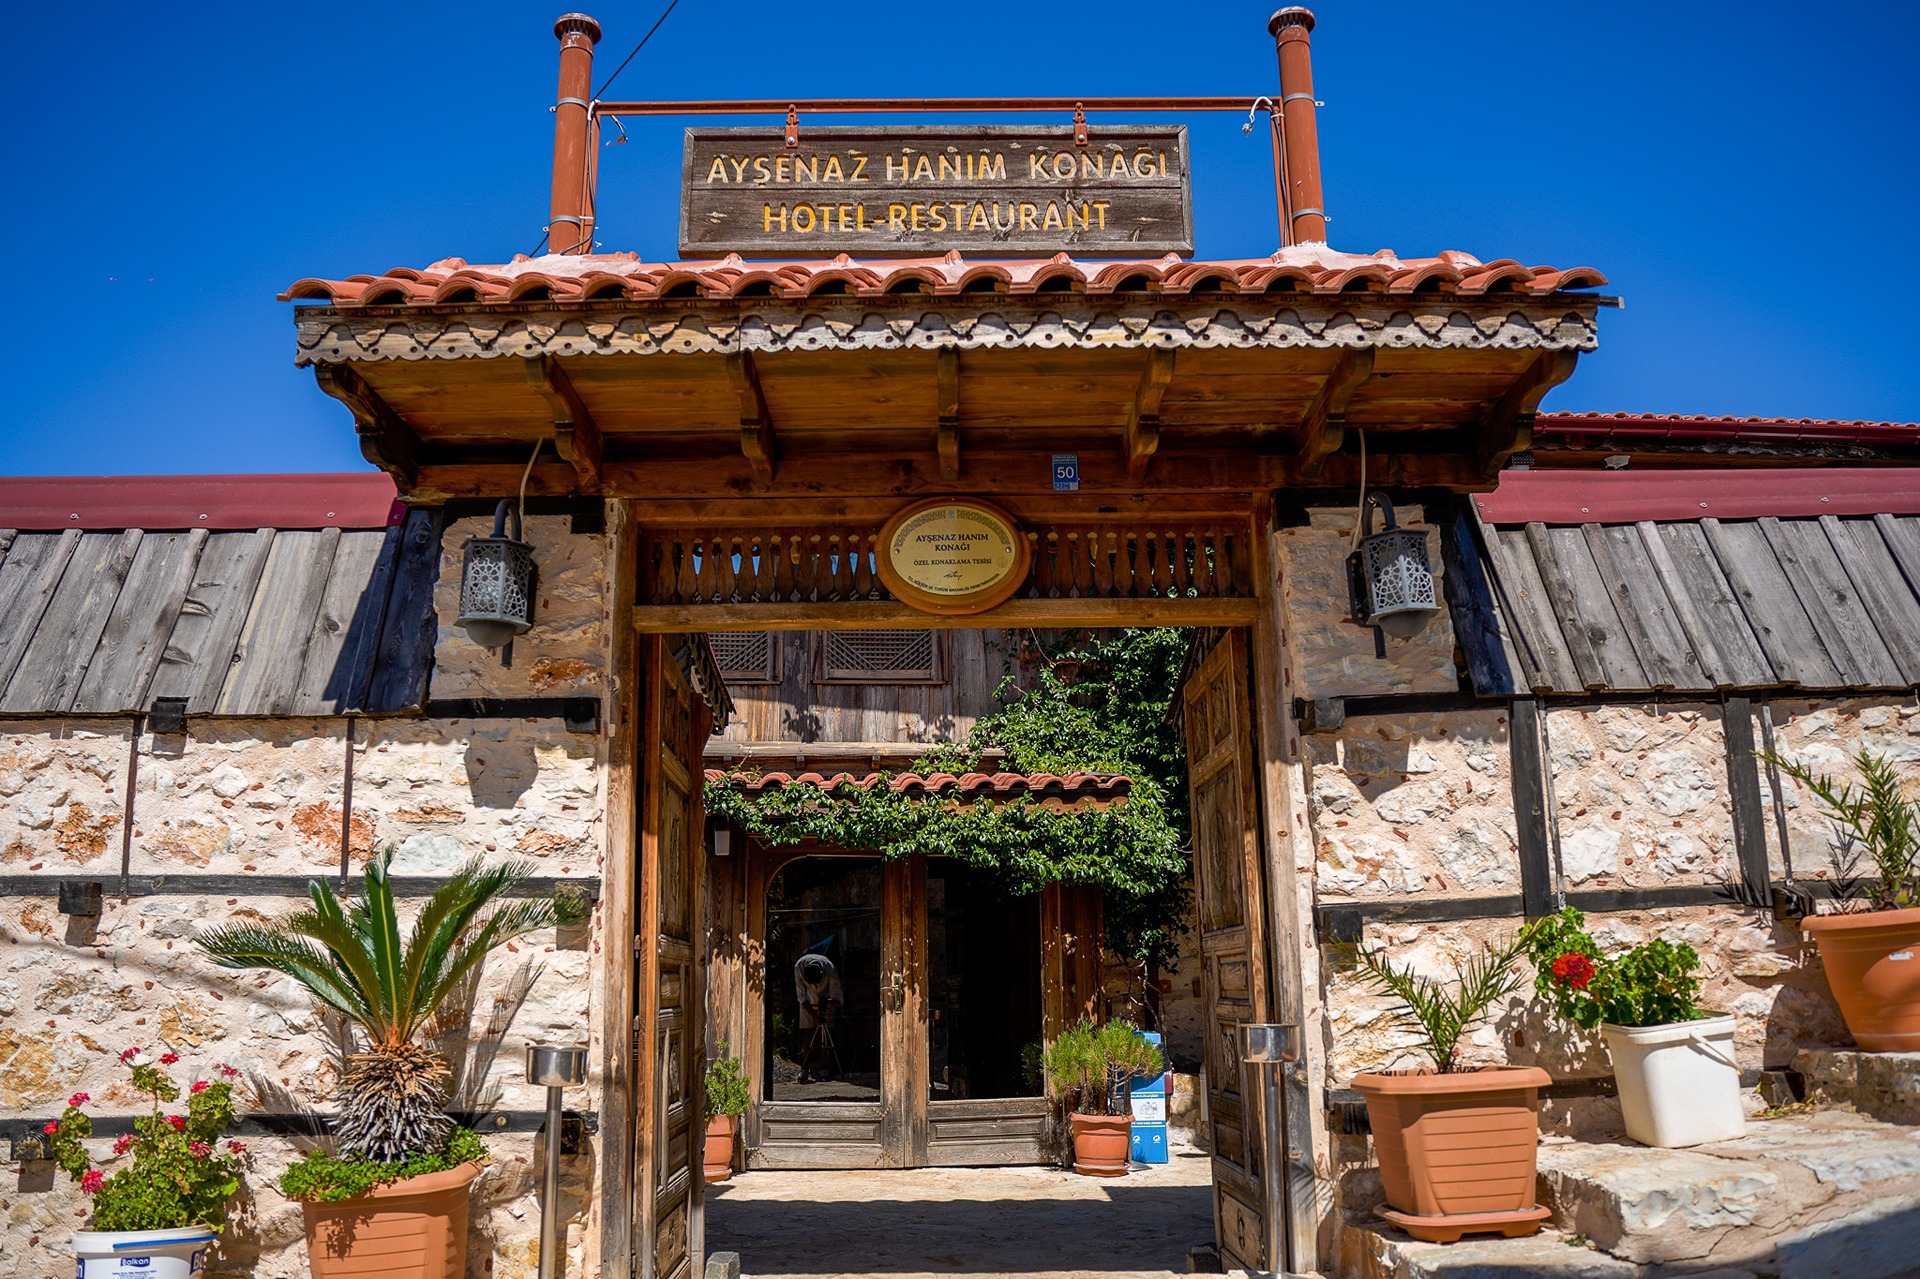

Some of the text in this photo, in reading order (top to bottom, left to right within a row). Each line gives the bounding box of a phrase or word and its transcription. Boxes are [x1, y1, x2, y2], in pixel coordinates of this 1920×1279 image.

[706, 143, 1168, 187] AYŞENAZ HANIM KONAĞI
[763, 199, 1111, 233] HOTEL-RESTAURANT
[1057, 466, 1075, 479] 50
[916, 533, 989, 543] AYŞENAZ HANIM
[935, 542, 971, 552] KONAĞI
[913, 558, 930, 566] ÖZEL
[972, 557, 992, 565] TESİSİ
[122, 1258, 149, 1266] Balkan
